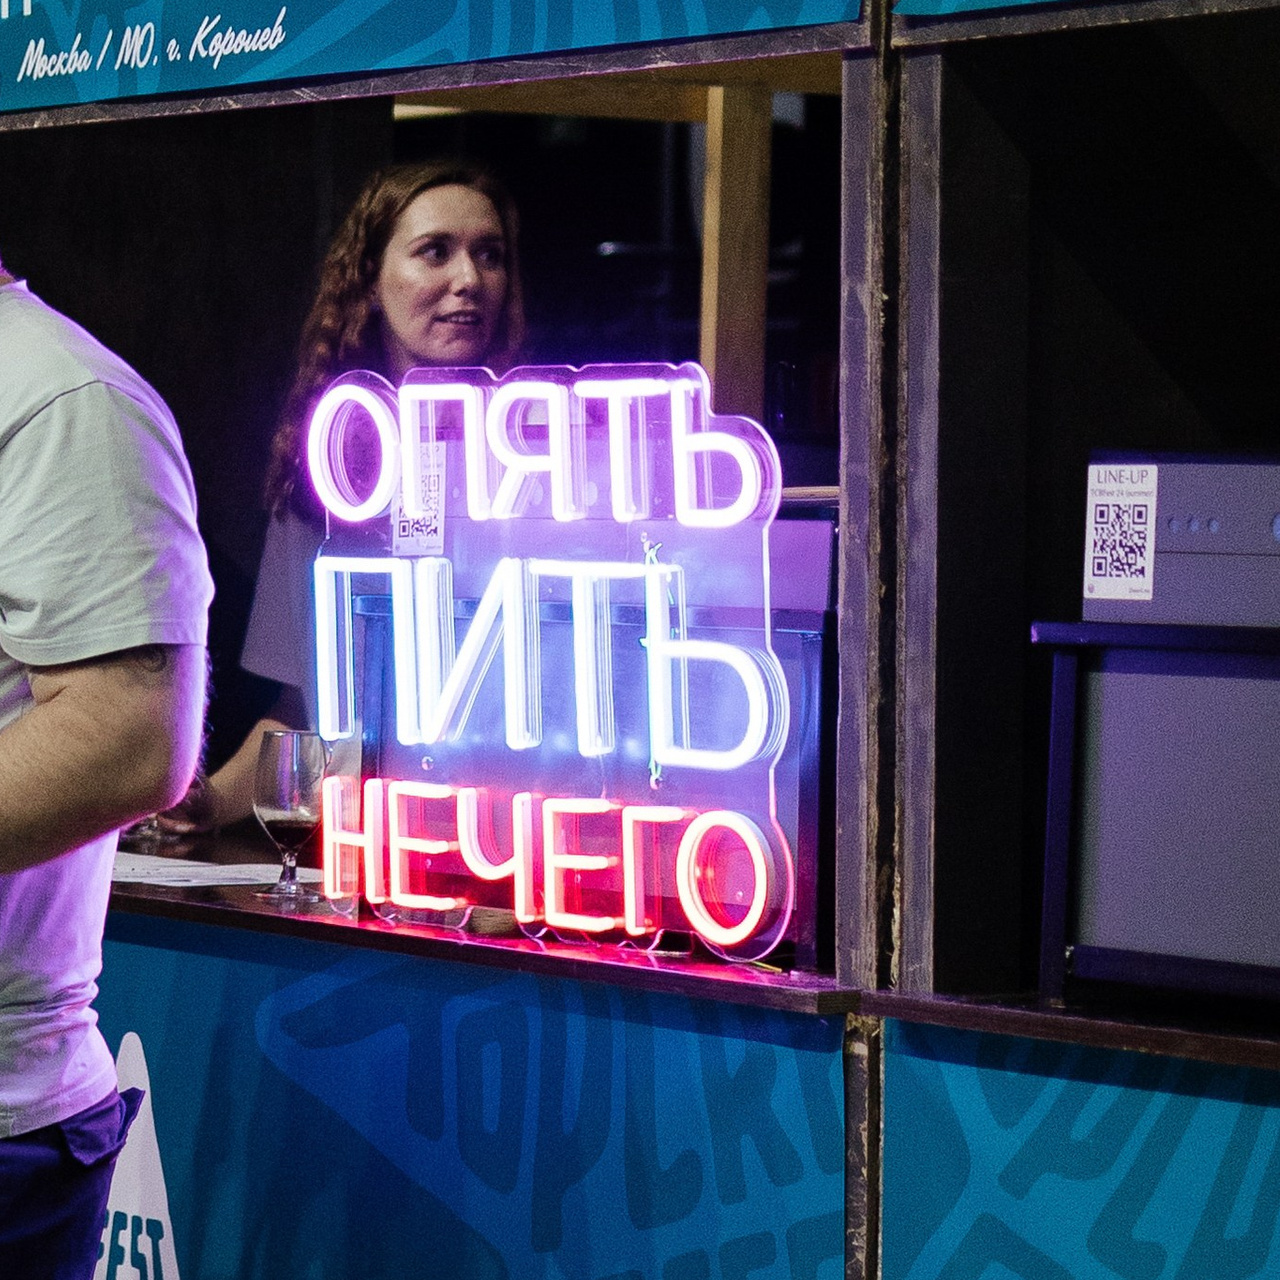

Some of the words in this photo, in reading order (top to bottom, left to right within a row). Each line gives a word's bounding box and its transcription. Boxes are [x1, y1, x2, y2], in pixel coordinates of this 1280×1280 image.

[16, 32, 93, 83] Москва
[307, 378, 764, 530] ОПЯТЬ
[1096, 469, 1149, 484] LINE-UP
[314, 556, 775, 770] ПИТЬ
[322, 775, 771, 947] НЕЧЕГО
